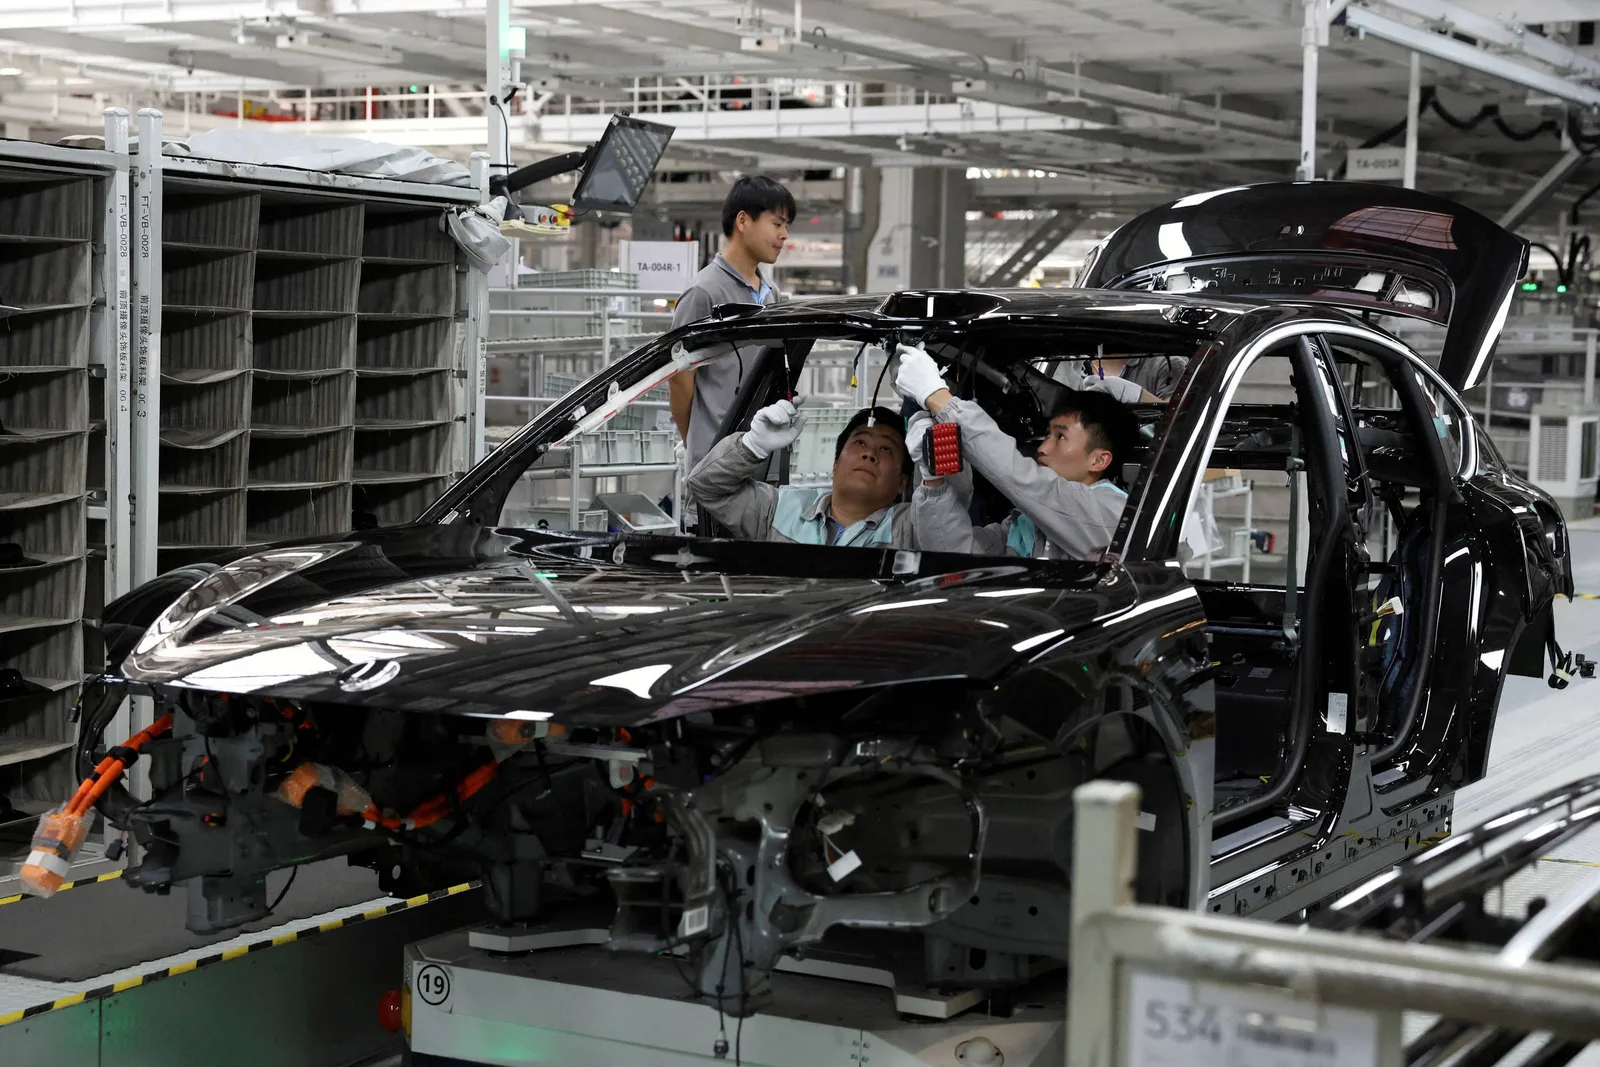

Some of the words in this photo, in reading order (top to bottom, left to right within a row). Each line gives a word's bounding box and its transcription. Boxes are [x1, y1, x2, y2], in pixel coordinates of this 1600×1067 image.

[119, 194, 128, 258] FT-VB-0028
[141, 195, 149, 258] FT-VB-0028
[637, 262, 681, 272] TA-004R-1
[423, 974, 445, 995] 19
